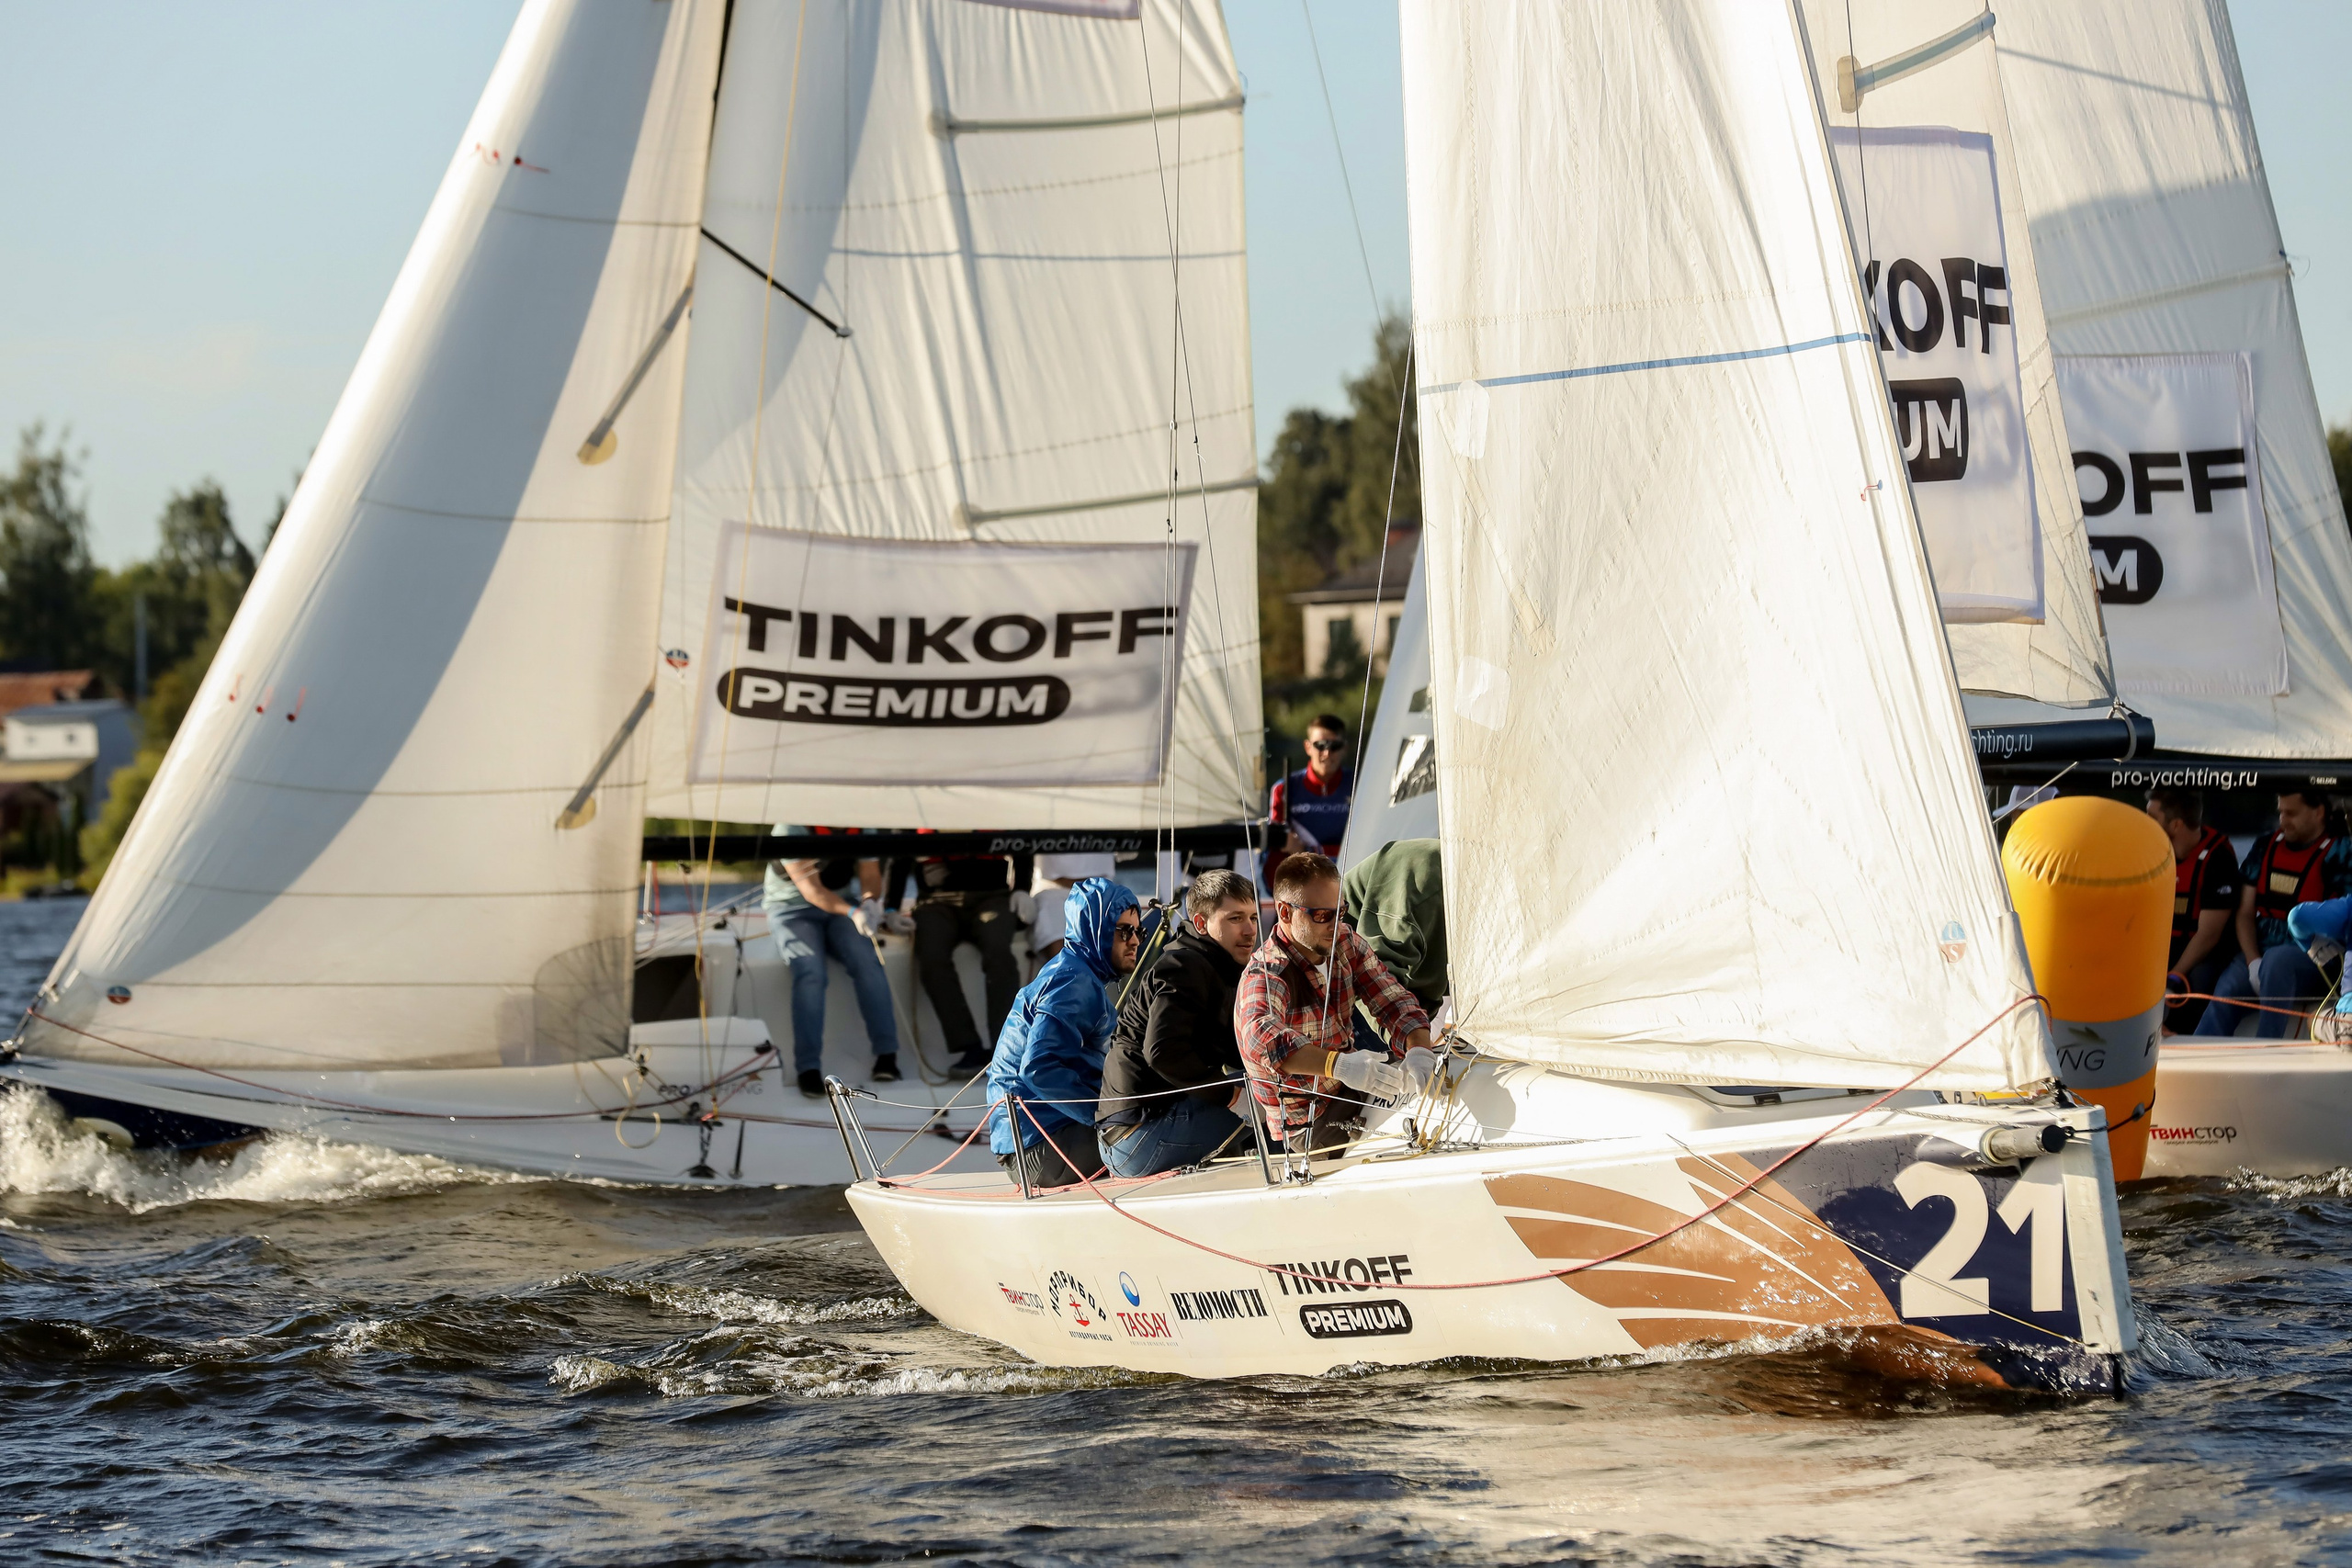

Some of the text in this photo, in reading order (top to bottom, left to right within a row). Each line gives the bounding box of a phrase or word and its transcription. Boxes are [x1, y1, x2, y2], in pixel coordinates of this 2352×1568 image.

[2071, 447, 2247, 516] OFF
[724, 595, 1179, 664] TINKOFF
[738, 675, 1049, 719] PREMIUM
[2111, 766, 2258, 791] pro-yachting.ru
[989, 834, 1142, 853] pro-yachting.ru
[1893, 1157, 2064, 1319] 21
[1268, 1255, 1413, 1296] TINKOFF
[1170, 1288, 1270, 1324] ВЕДОМОСТИ
[1305, 1305, 1408, 1333] PREMIUM
[1116, 1313, 1173, 1338] TASSAY
